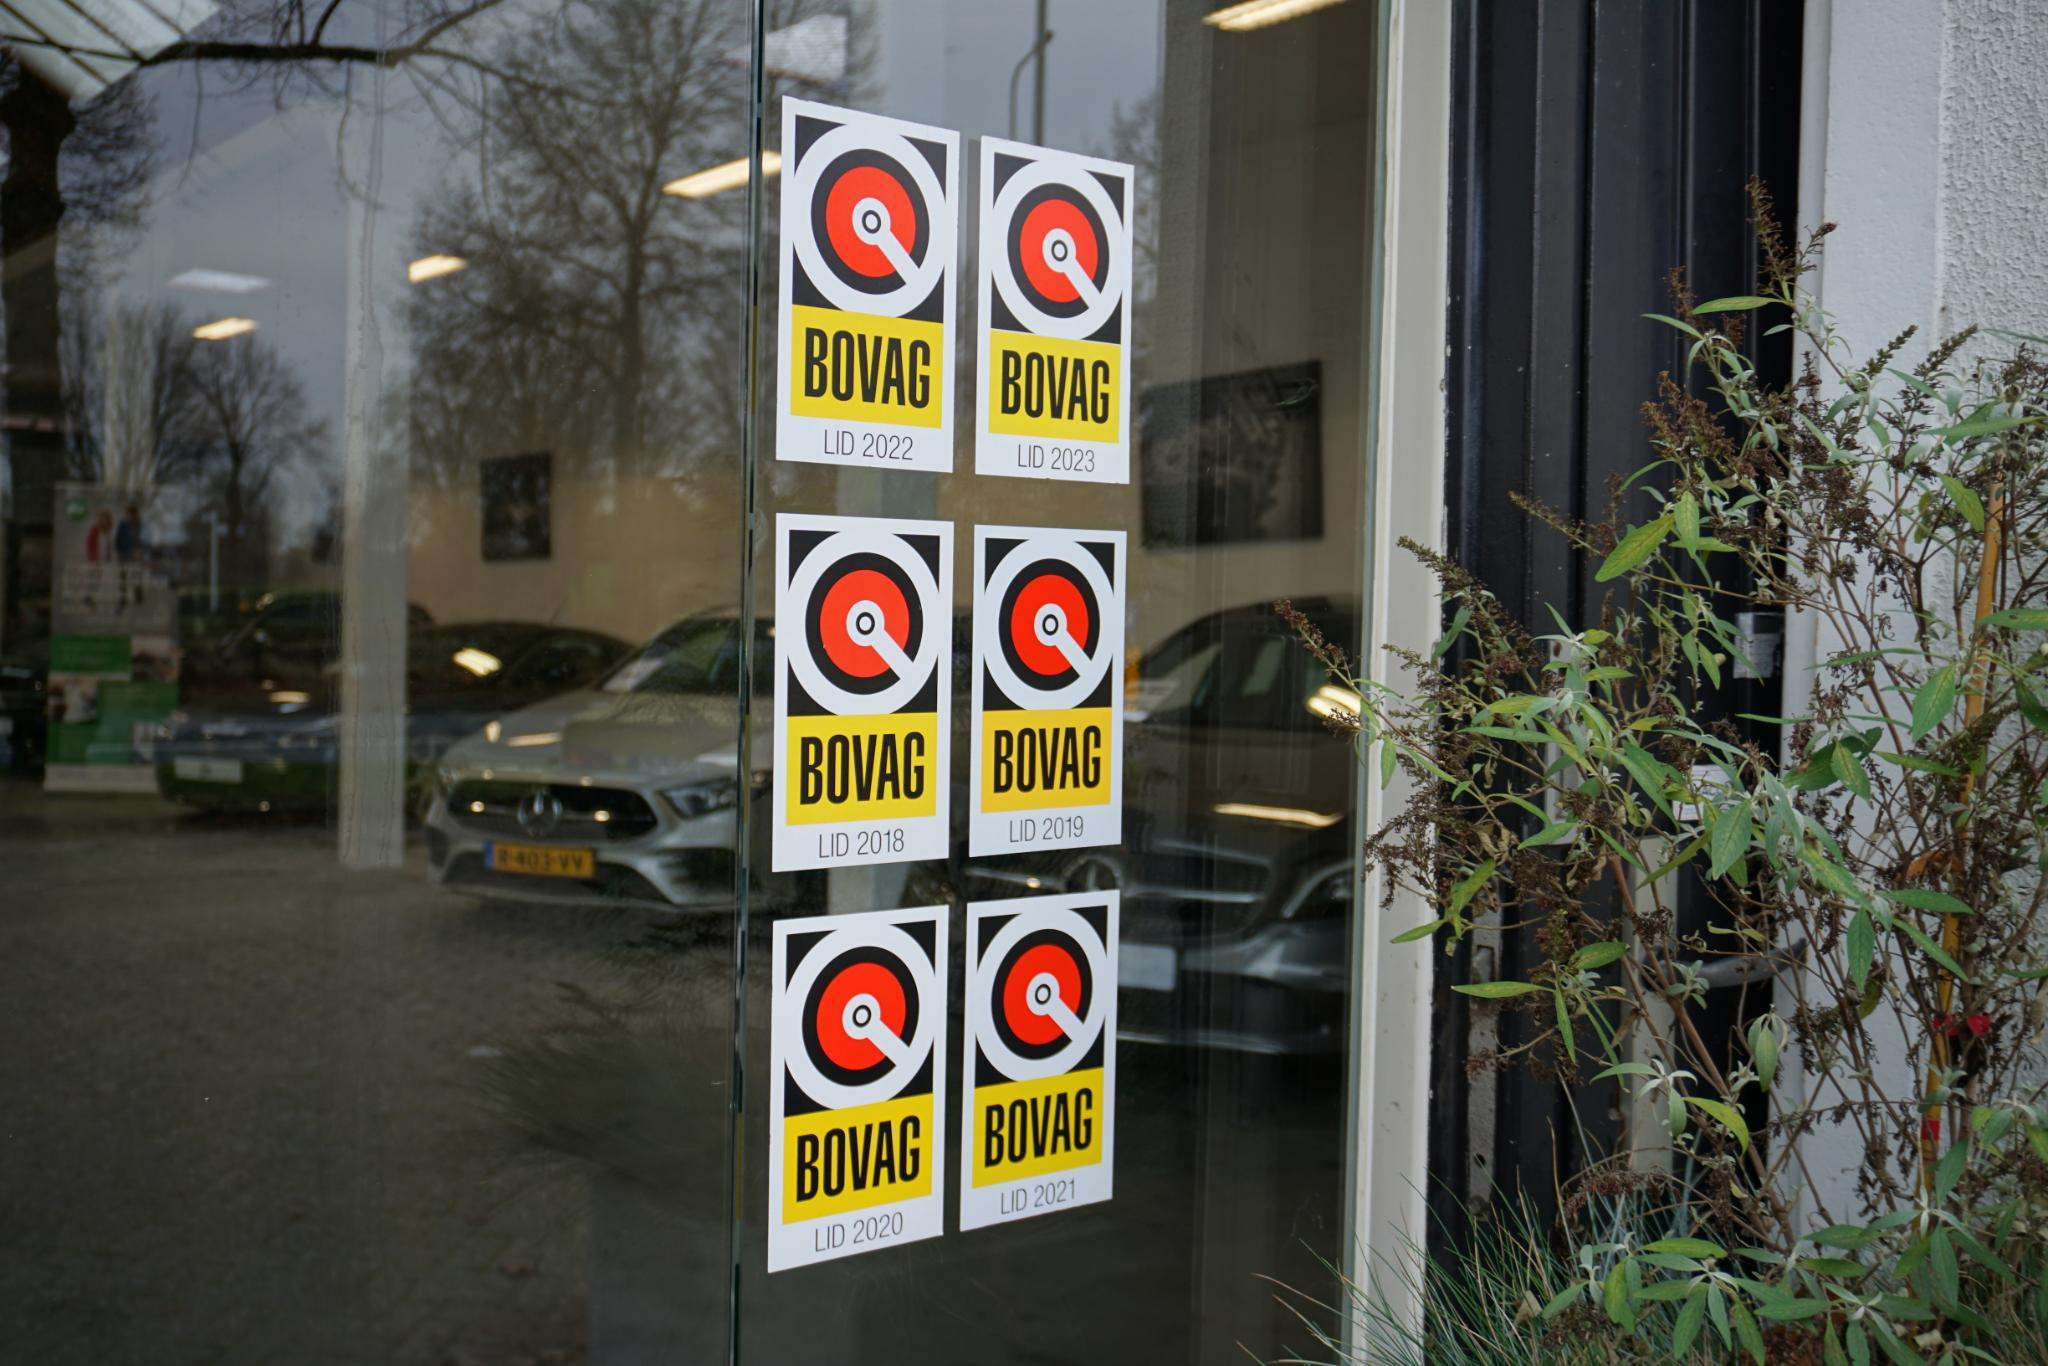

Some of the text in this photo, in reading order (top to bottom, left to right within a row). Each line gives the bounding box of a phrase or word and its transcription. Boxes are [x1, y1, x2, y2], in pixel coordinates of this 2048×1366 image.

[805, 327, 930, 408] BOVAG
[1001, 350, 1109, 424] BOVAG
[825, 429, 913, 460] LID 2022
[1018, 444, 1094, 472] LID 2023
[800, 732, 924, 805] BOVAG
[994, 725, 1101, 793] BOVAG
[819, 829, 904, 858] LID 2018
[1010, 816, 1083, 842] LID 2019
[984, 1087, 1093, 1168] BOVAG
[796, 1115, 920, 1203] BOVAG
[1001, 1179, 1076, 1215] LID 2021
[815, 1212, 903, 1252] LID 2020
